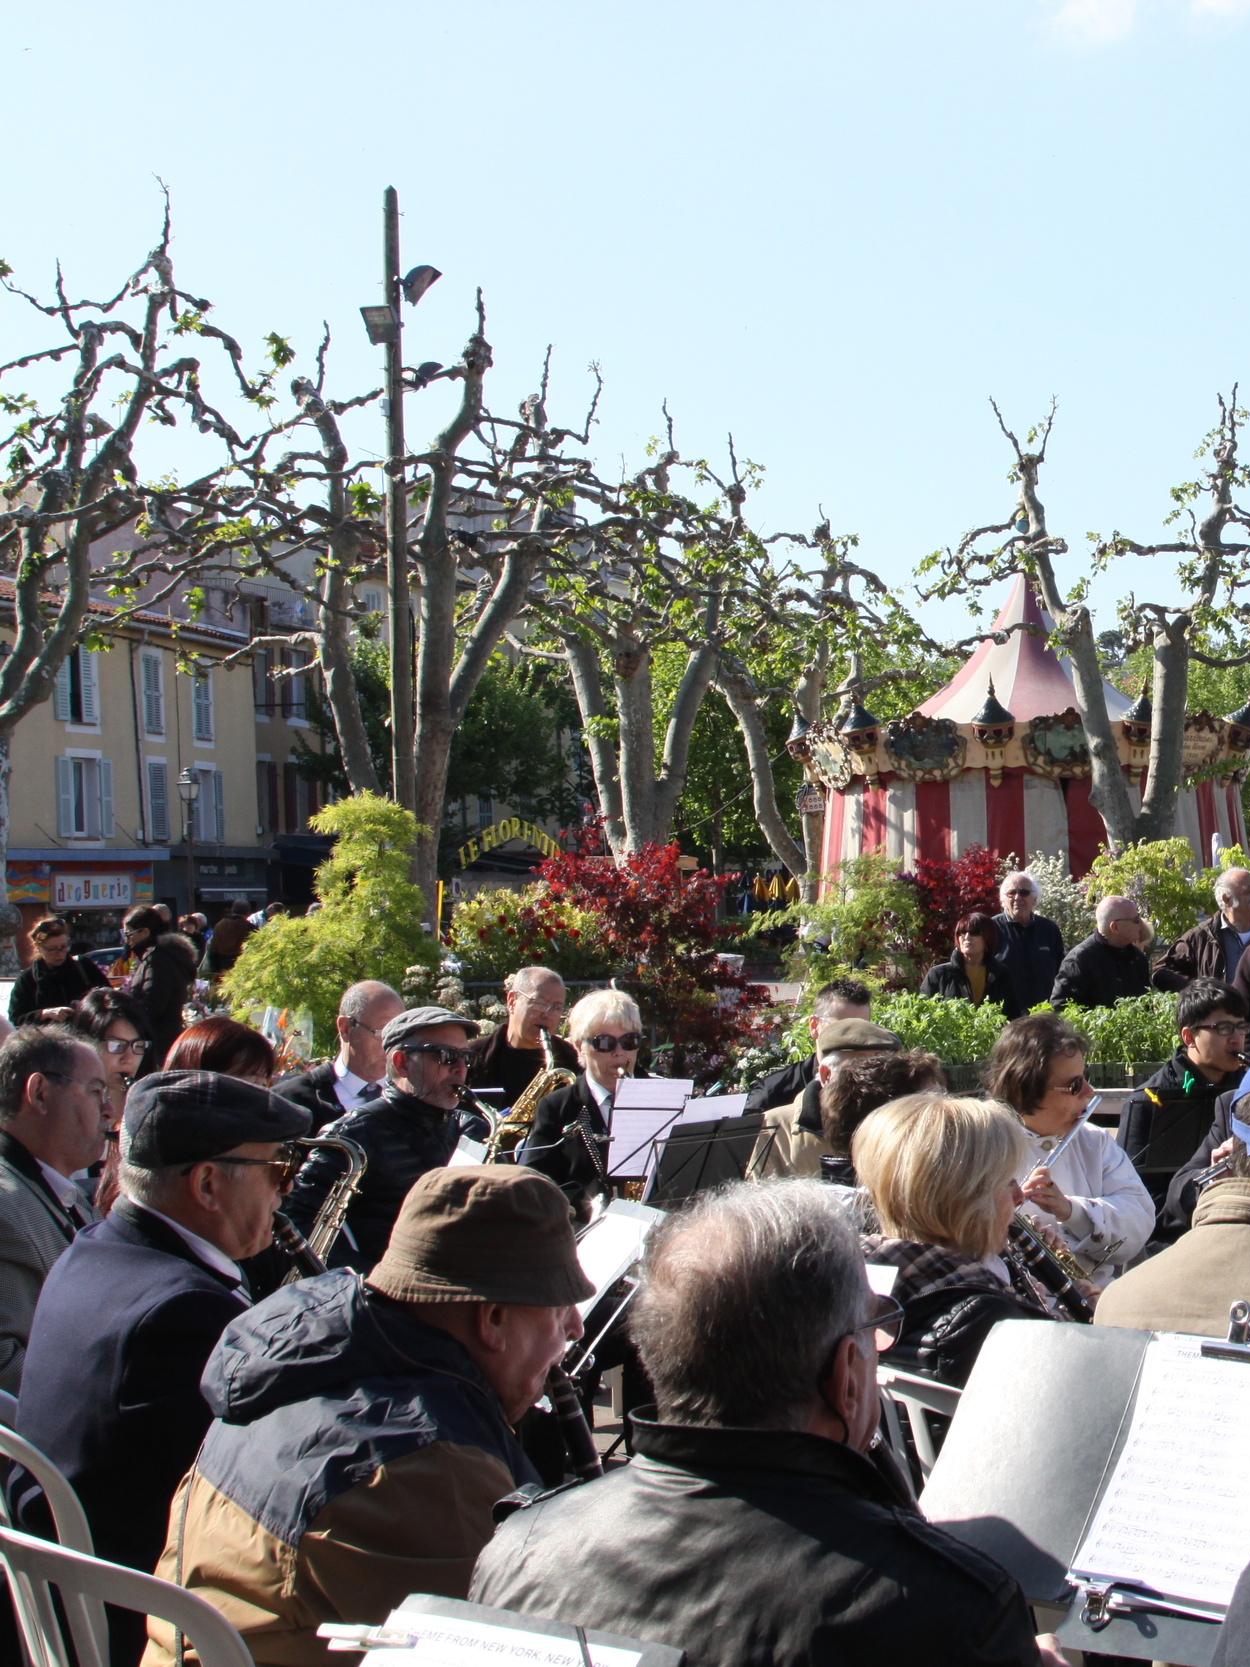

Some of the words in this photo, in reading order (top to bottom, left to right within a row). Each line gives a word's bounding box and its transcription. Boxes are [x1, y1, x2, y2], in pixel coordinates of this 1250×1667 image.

[458, 838, 480, 869] LE
[58, 877, 128, 902] droguerie
[446, 1634, 478, 1648] FROM
[480, 1640, 507, 1653] NEW
[509, 1645, 542, 1661] YORK,
[545, 1652, 575, 1667] NEW
